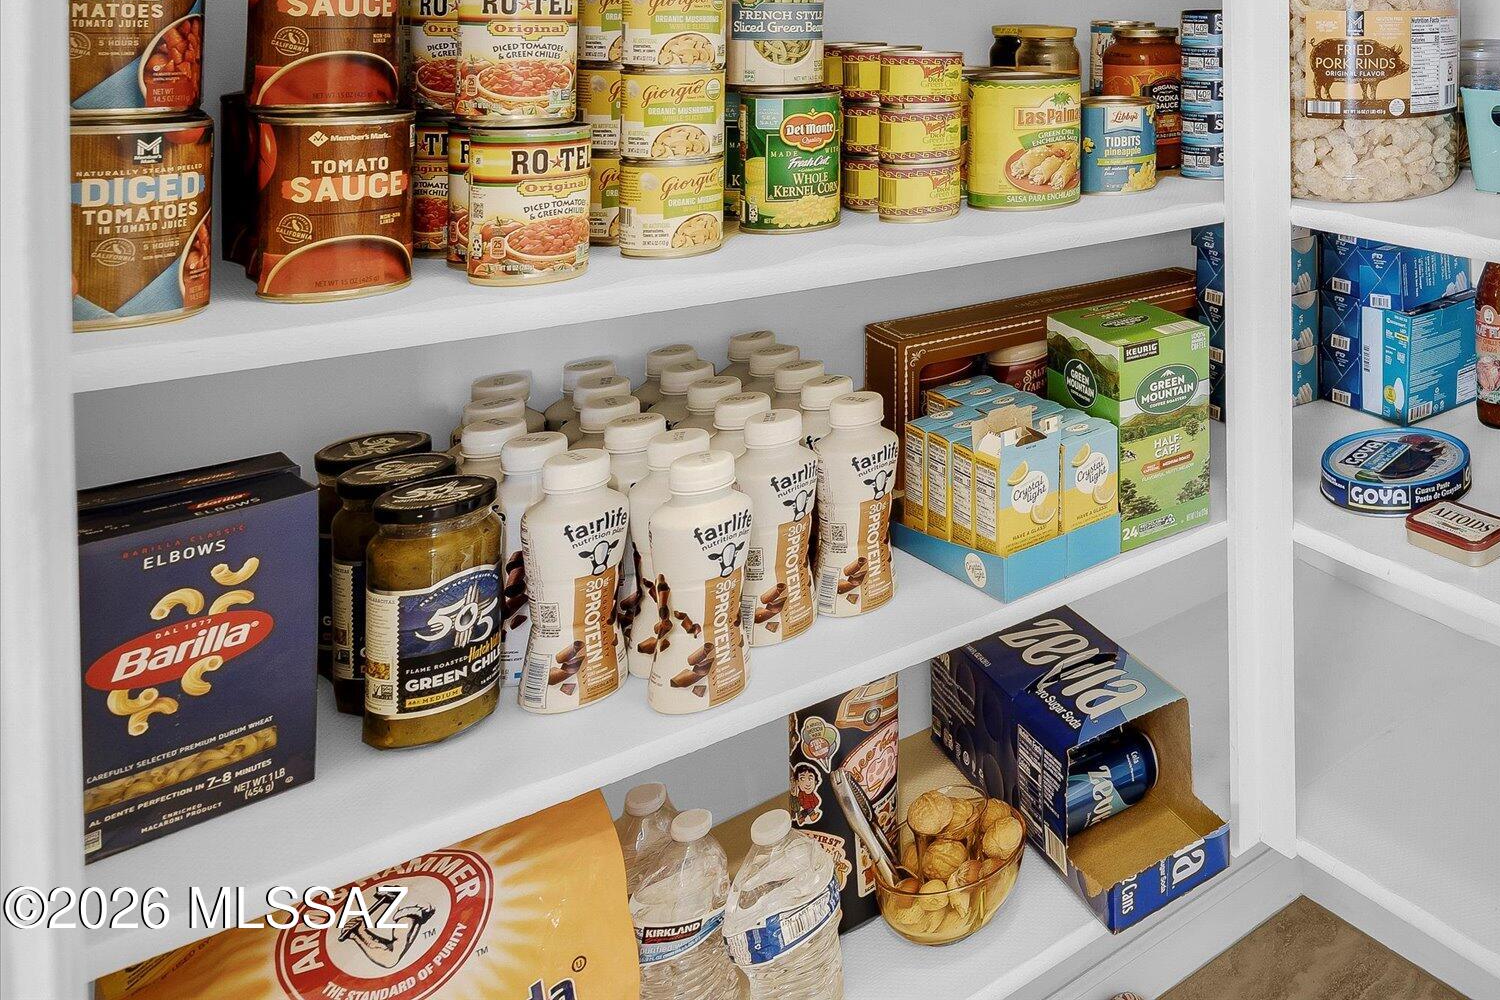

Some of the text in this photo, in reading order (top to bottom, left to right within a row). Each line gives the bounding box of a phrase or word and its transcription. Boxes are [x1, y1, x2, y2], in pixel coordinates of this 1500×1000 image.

[739, 10, 793, 21] FRENCH
[72, 20, 149, 28] TOMATO JUICE
[494, 23, 565, 35] Original
[734, 21, 803, 33] Sliced Green
[505, 50, 533, 59] GREEN
[1337, 44, 1374, 56] FRIED
[1315, 57, 1396, 70] PORK RINDS
[785, 122, 834, 136] Del Monte
[1105, 136, 1141, 148] TIDBITS
[1104, 146, 1142, 157] pineapple
[76, 169, 138, 177] NATURALLY
[793, 172, 829, 184] WHOLE
[80, 172, 200, 208] DICED
[290, 170, 403, 204] SAUCE
[773, 184, 816, 197] KERNEL
[1006, 193, 1046, 203] SALSA PARA
[82, 201, 198, 226] TOMATOES
[99, 218, 187, 235] IN TOMATO JUICE
[1126, 343, 1158, 357] KEURIG
[1150, 376, 1185, 392] GREEN
[1141, 383, 1194, 405] MOUNTAIN
[1154, 443, 1180, 460] CAFF
[1013, 475, 1046, 503] Crystal
[1026, 483, 1047, 504] light
[1350, 486, 1407, 505] GOYA
[1415, 486, 1435, 495] Guava
[1415, 494, 1430, 504] Pasta
[1430, 507, 1494, 533] ALTOIDS
[1122, 526, 1138, 541] 24
[142, 539, 227, 571] ELBOWS
[415, 596, 499, 643] 505
[584, 591, 603, 664] PROTEIN
[155, 618, 213, 640] DAL 1877
[111, 621, 252, 683] Barilla
[405, 665, 431, 676] FLAME
[404, 669, 468, 693] GREEN
[421, 689, 460, 705] MEDIUM
[86, 715, 274, 784] CAREFULLY SELECTED PREMIUM DURUM WHEAT
[275, 768, 286, 782] LB
[89, 758, 273, 829] AL DENTE PERFECTION 7-8 MINUTES
[1120, 883, 1134, 915] Cans
[645, 920, 701, 946] KIRKLAND
[432, 923, 467, 970] PURITY
